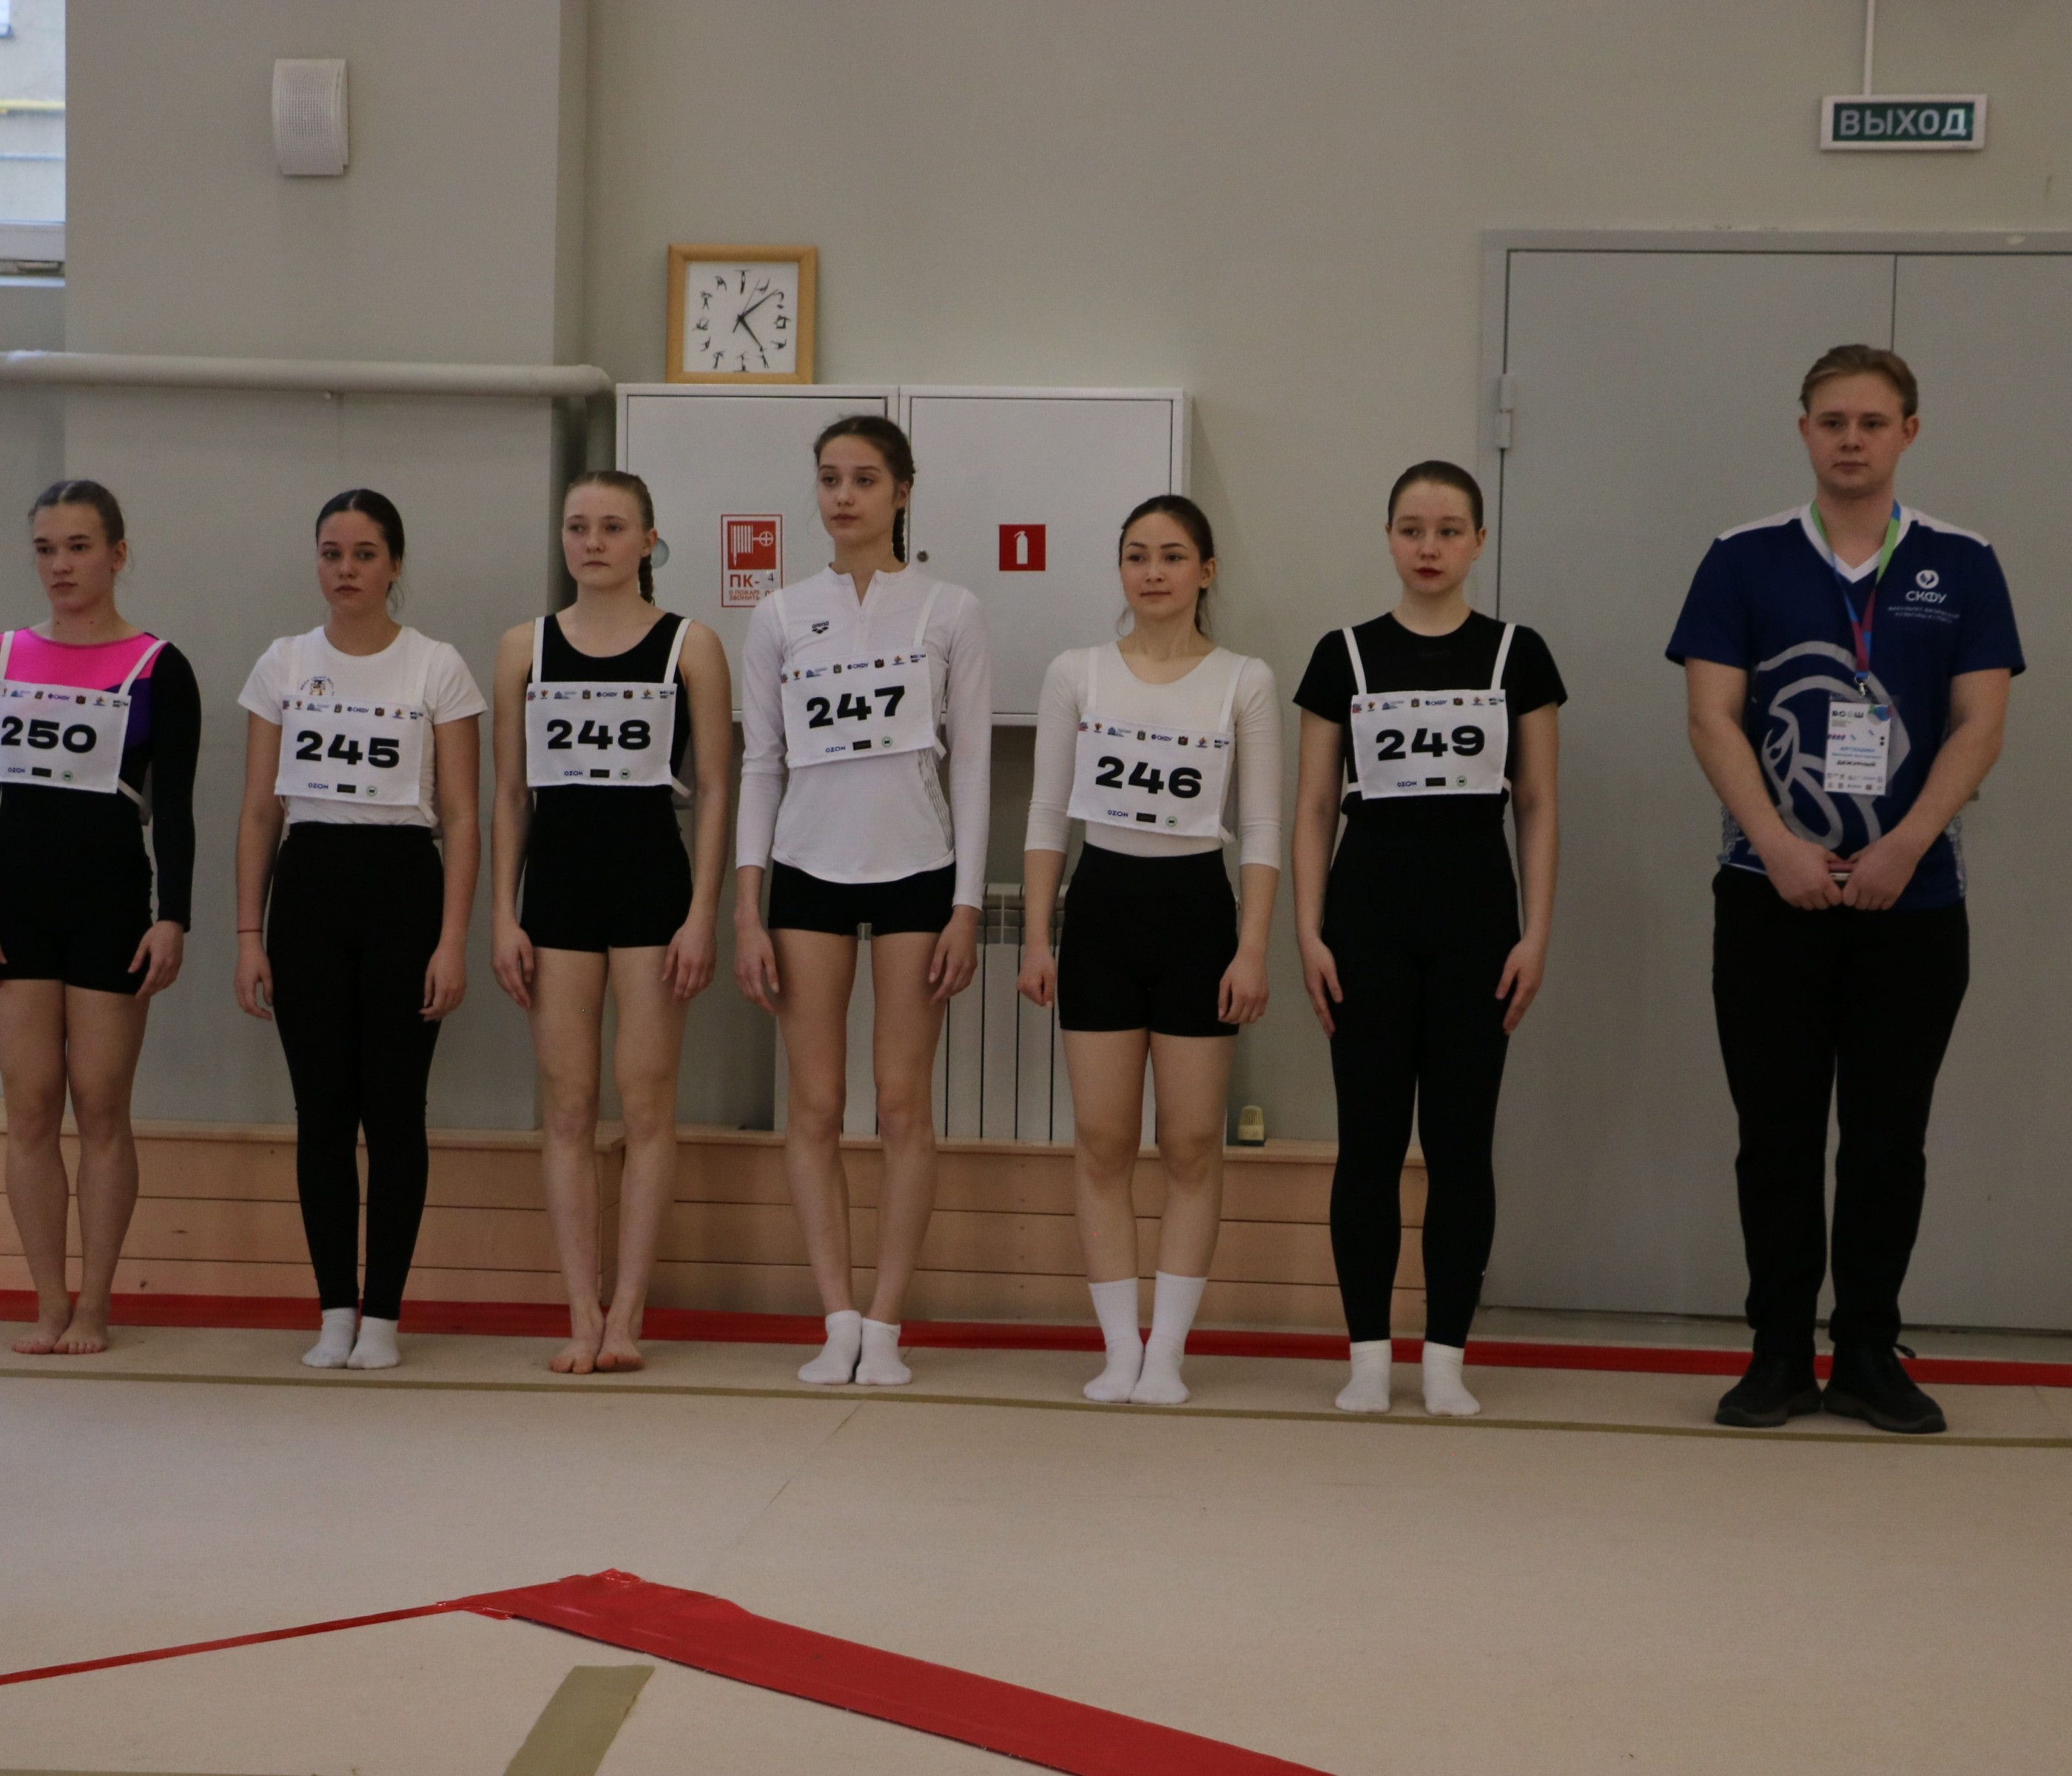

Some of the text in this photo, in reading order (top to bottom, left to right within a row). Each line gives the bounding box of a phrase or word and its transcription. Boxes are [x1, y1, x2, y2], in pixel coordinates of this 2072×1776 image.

[1840, 108, 1967, 137] ВЫХОД
[1905, 591, 1947, 604] СКФУ
[812, 621, 829, 629] arena
[807, 685, 905, 729] 247
[1, 716, 97, 753] 250
[296, 730, 400, 768] 245
[547, 719, 651, 750] 248
[825, 745, 846, 753] OZON
[1376, 725, 1485, 761] 249
[1095, 756, 1202, 798] 246
